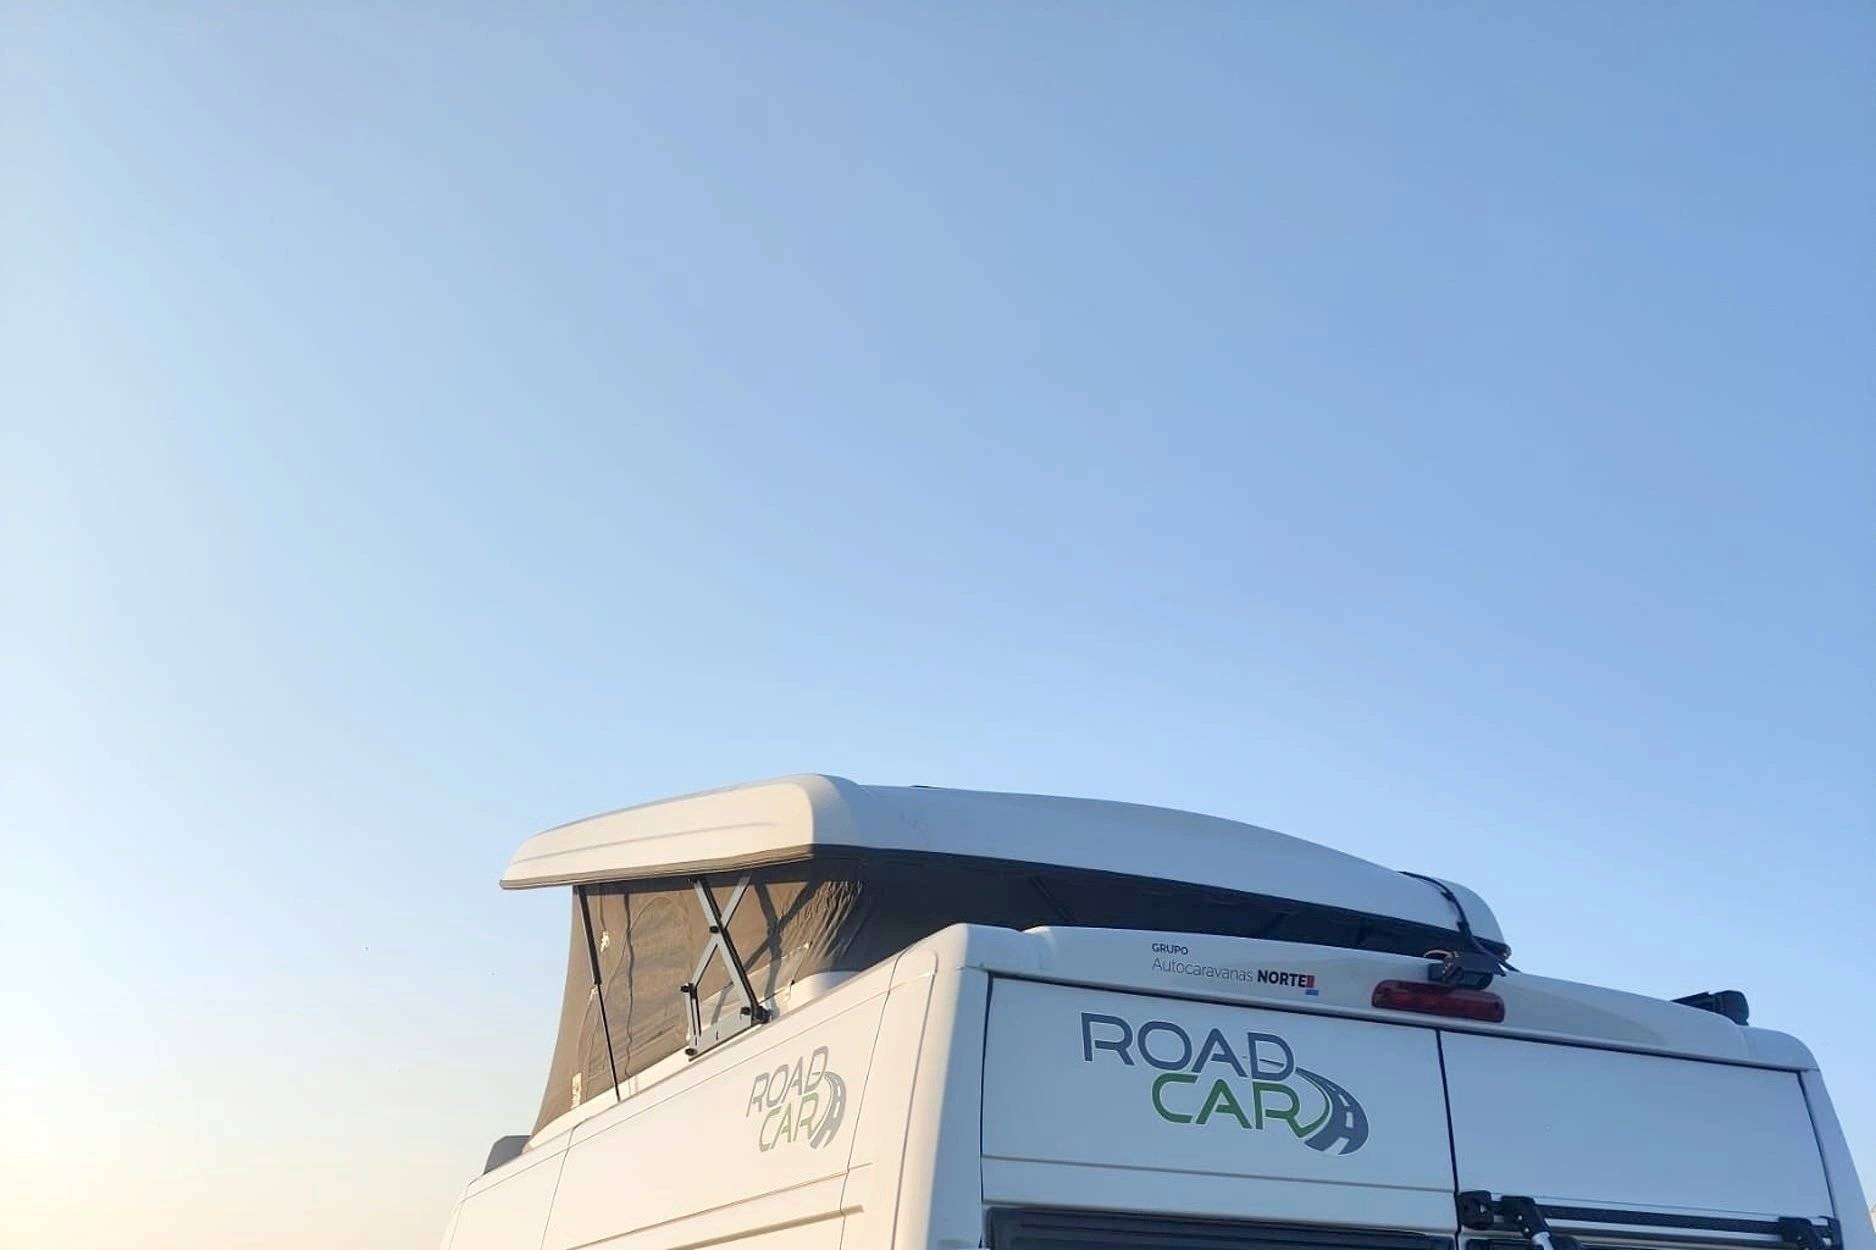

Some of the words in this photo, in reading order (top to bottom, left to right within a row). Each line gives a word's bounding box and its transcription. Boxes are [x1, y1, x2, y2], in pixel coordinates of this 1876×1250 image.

[1151, 942, 1189, 956] GRUPO
[1152, 957, 1253, 983] Autocaravanas
[1257, 969, 1306, 988] NORTE
[1081, 1011, 1296, 1082] ROAD
[745, 1045, 829, 1118] ROAD
[1152, 1071, 1306, 1138] CAR
[759, 1091, 820, 1153] CAR
